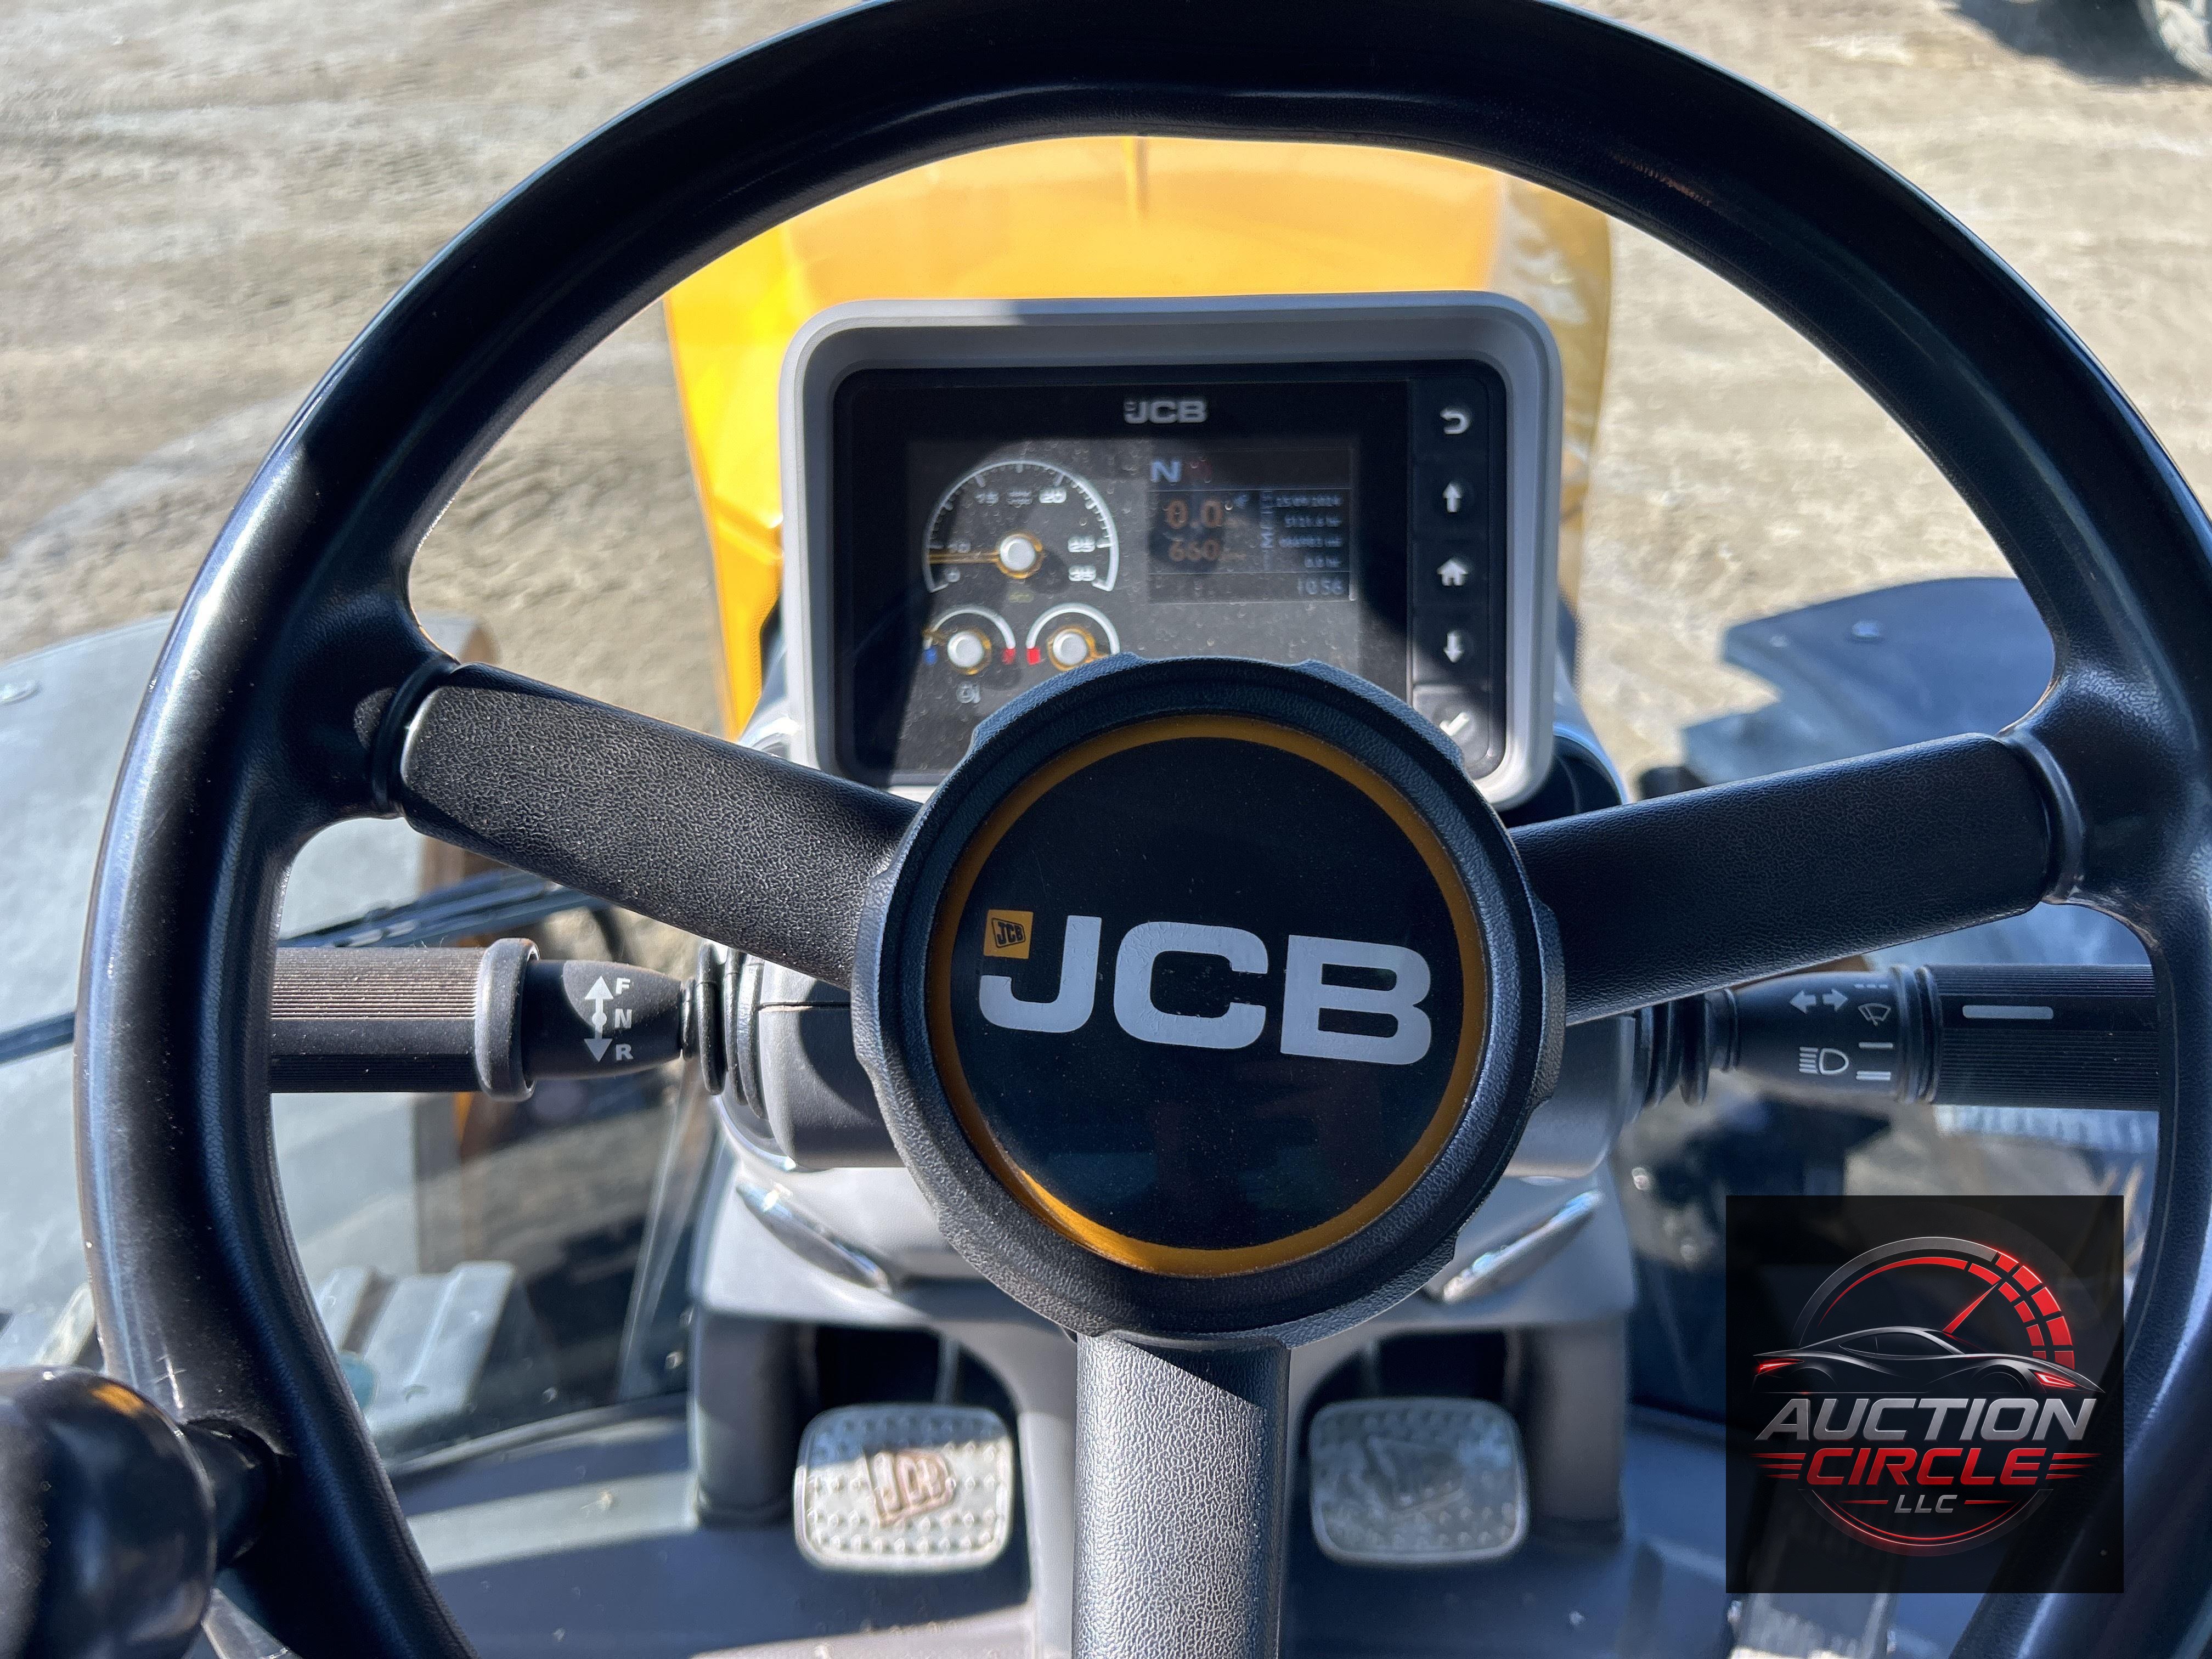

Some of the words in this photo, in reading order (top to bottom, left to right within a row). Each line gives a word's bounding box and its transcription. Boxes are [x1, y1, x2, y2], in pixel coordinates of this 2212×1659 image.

[1125, 400, 1207, 424] JCB
[1152, 461, 1181, 483] N
[1166, 498, 1224, 529] 0.0
[1297, 578, 1344, 596] 1056
[997, 921, 1024, 945] JCB
[616, 977, 630, 995] F
[979, 915, 1431, 1065] JCB
[614, 1008, 632, 1029] N
[616, 1043, 634, 1061] R
